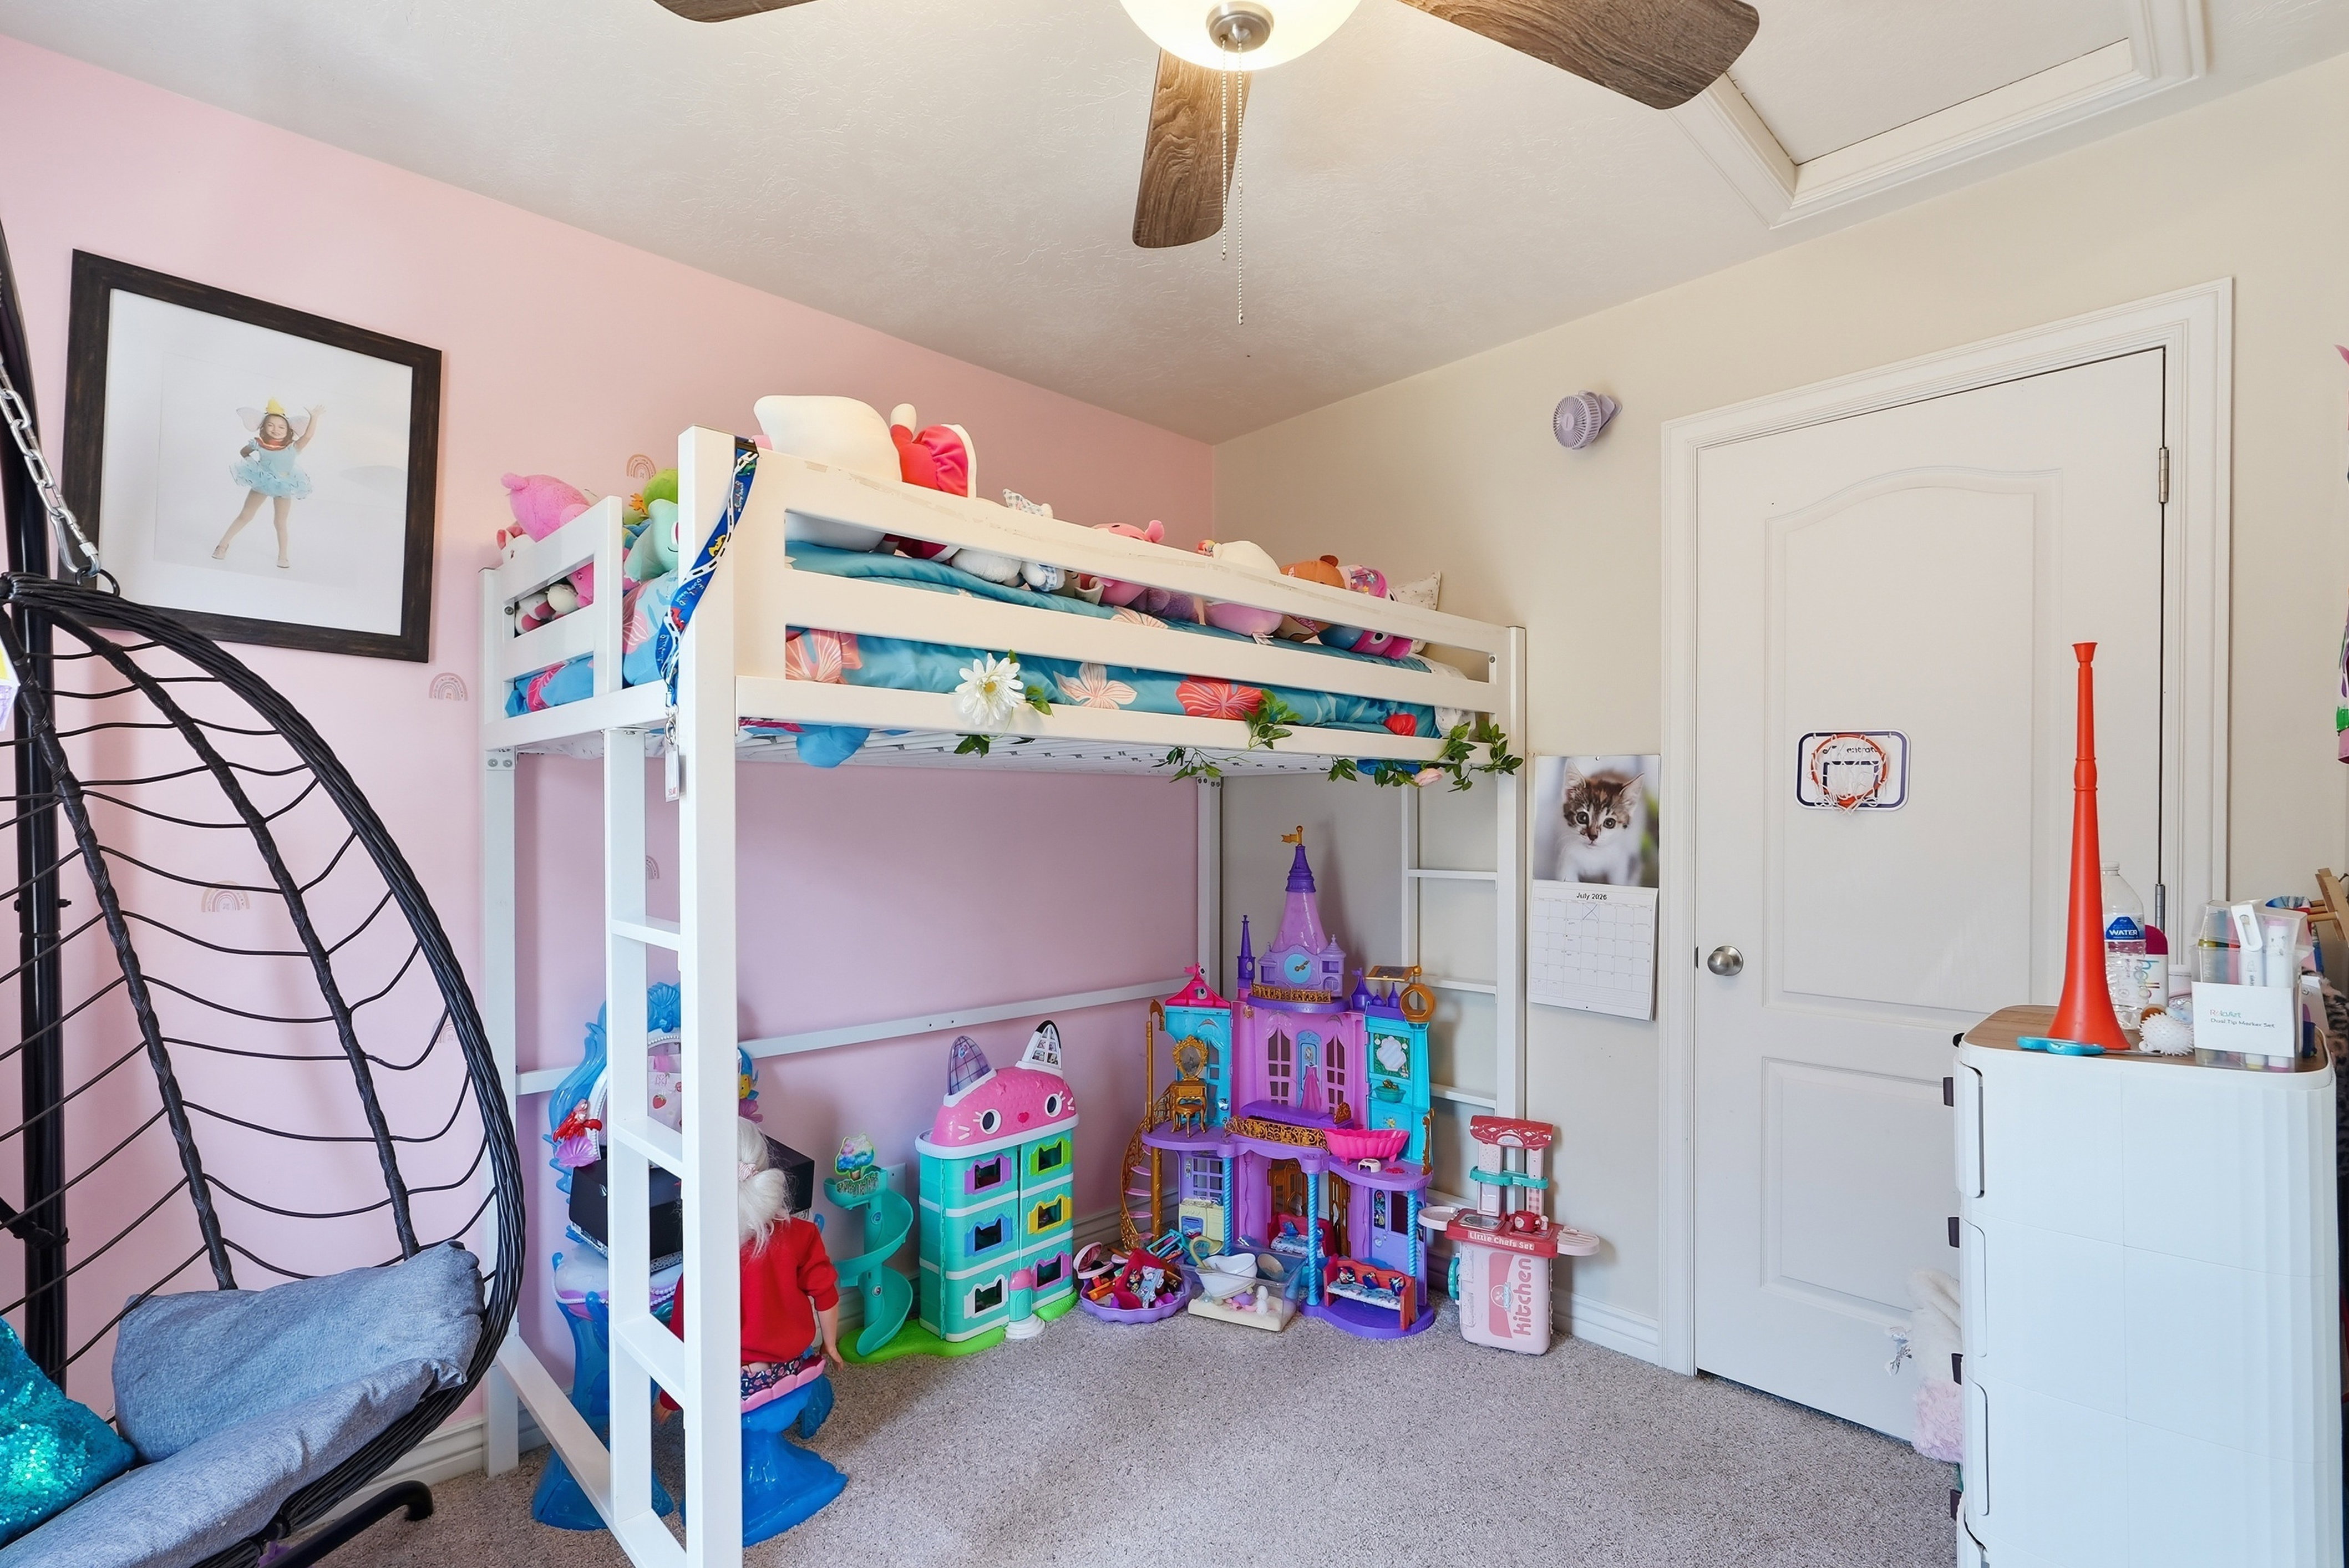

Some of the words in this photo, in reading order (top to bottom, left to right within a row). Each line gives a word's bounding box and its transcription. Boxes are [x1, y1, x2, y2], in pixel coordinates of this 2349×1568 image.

[1469, 1232, 1492, 1242] Little
[1494, 1237, 1517, 1247] Chefs
[1519, 1242, 1534, 1250] Set
[1513, 1258, 1531, 1335] kitchen
